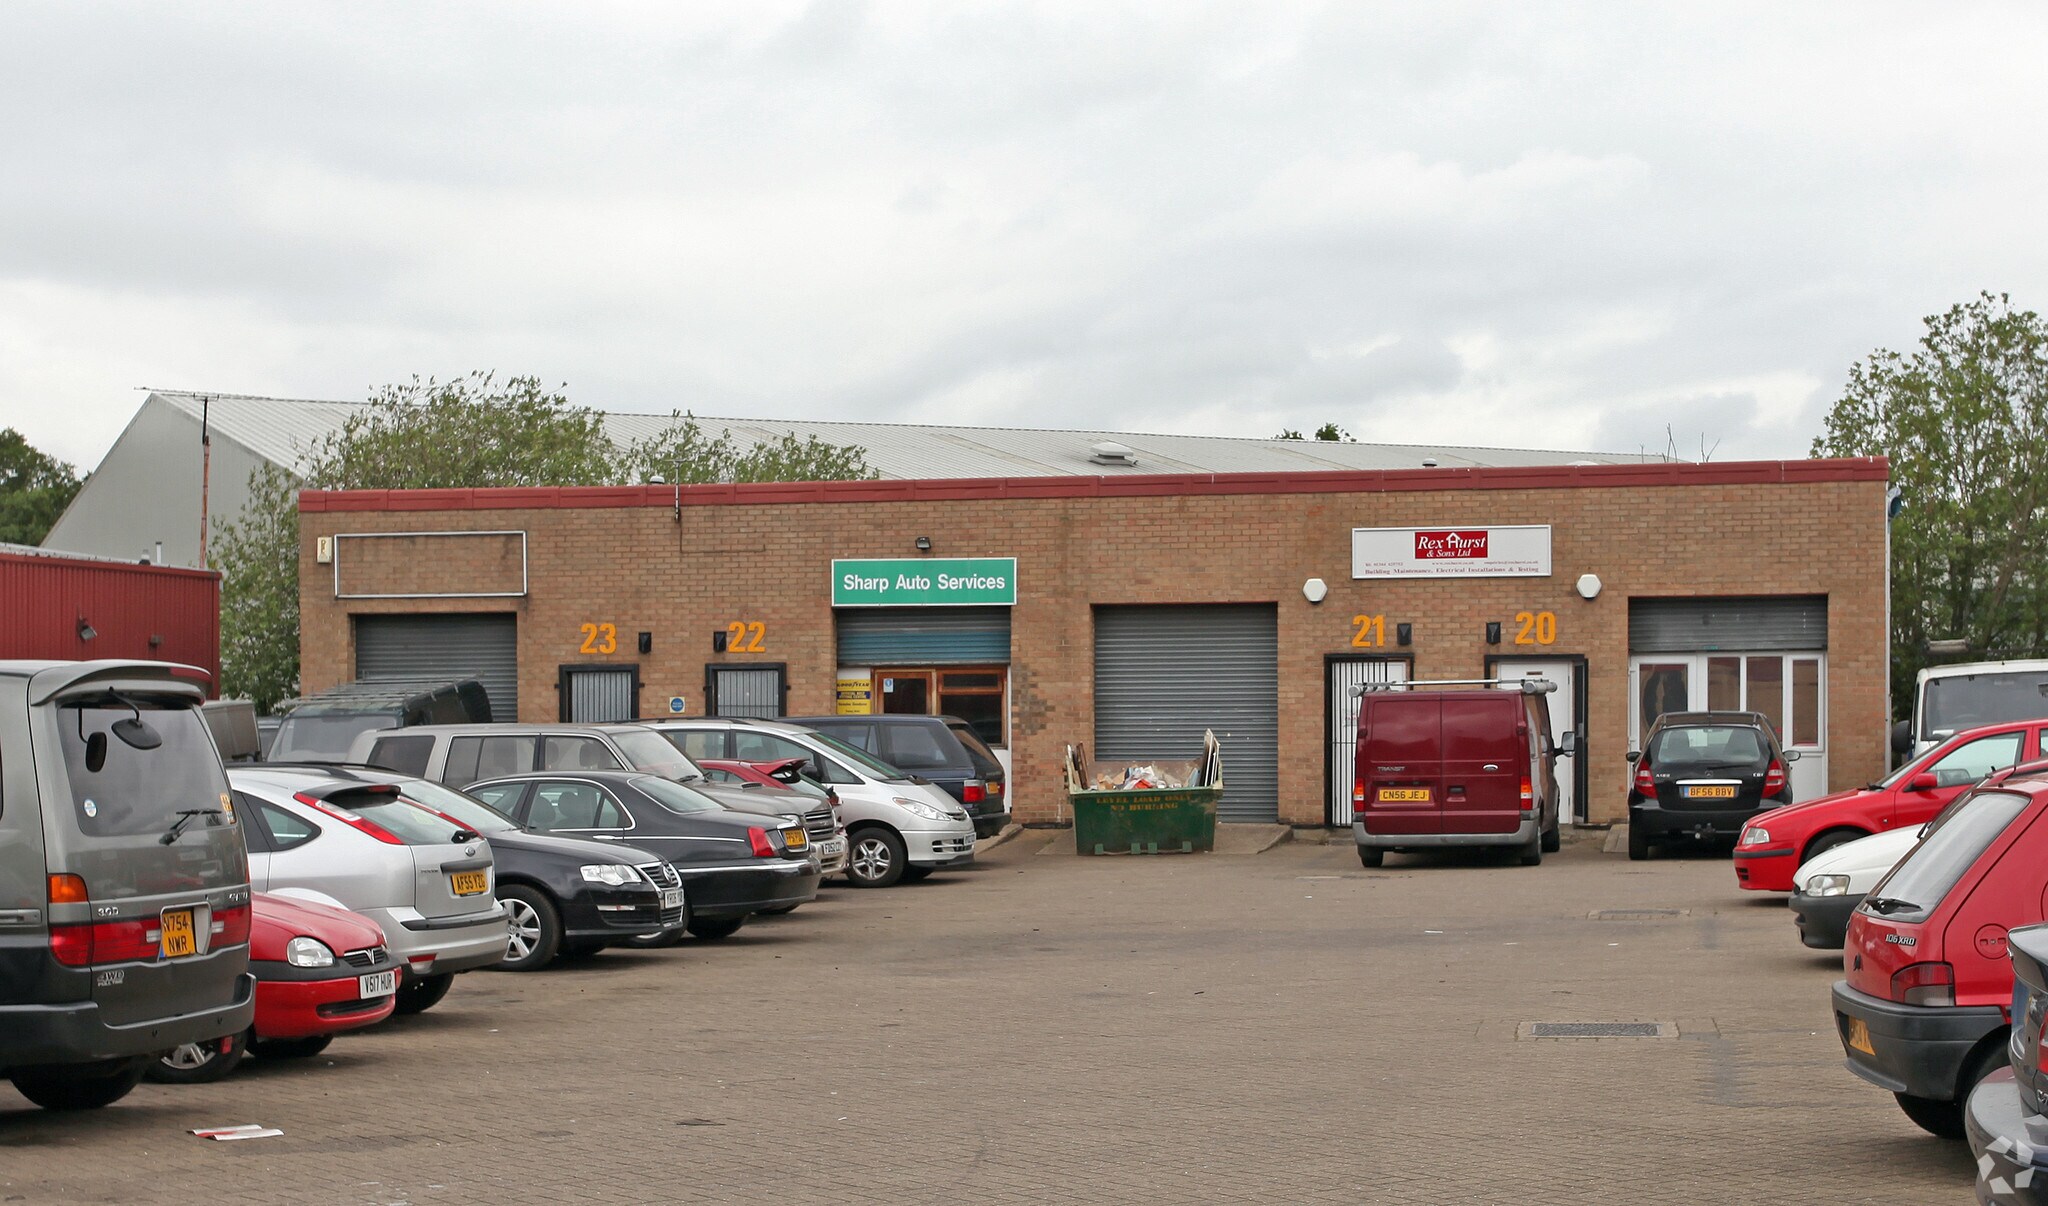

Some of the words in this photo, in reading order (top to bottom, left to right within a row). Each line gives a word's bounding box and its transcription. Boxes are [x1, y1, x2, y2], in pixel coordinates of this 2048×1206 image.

[1417, 536, 1444, 550] Rex
[1445, 532, 1486, 549] Hurst
[1426, 549, 1434, 558] &
[1436, 549, 1455, 557] Sons
[1457, 548, 1471, 557] Ltd
[843, 575, 890, 593] Sharp
[895, 574, 931, 590] Auto
[937, 573, 1006, 590] Services
[727, 621, 767, 653] 22
[1351, 615, 1385, 647] 21
[1514, 611, 1556, 645] 20
[579, 623, 618, 655] 23
[1382, 790, 1406, 799] CN56
[1408, 790, 1426, 799] JEJ
[1690, 786, 1713, 796] BF56
[1715, 786, 1733, 796] BBV
[456, 875, 473, 891] AF55
[163, 914, 189, 933] N754
[168, 935, 187, 953] NWR
[1885, 934, 1899, 944] 106
